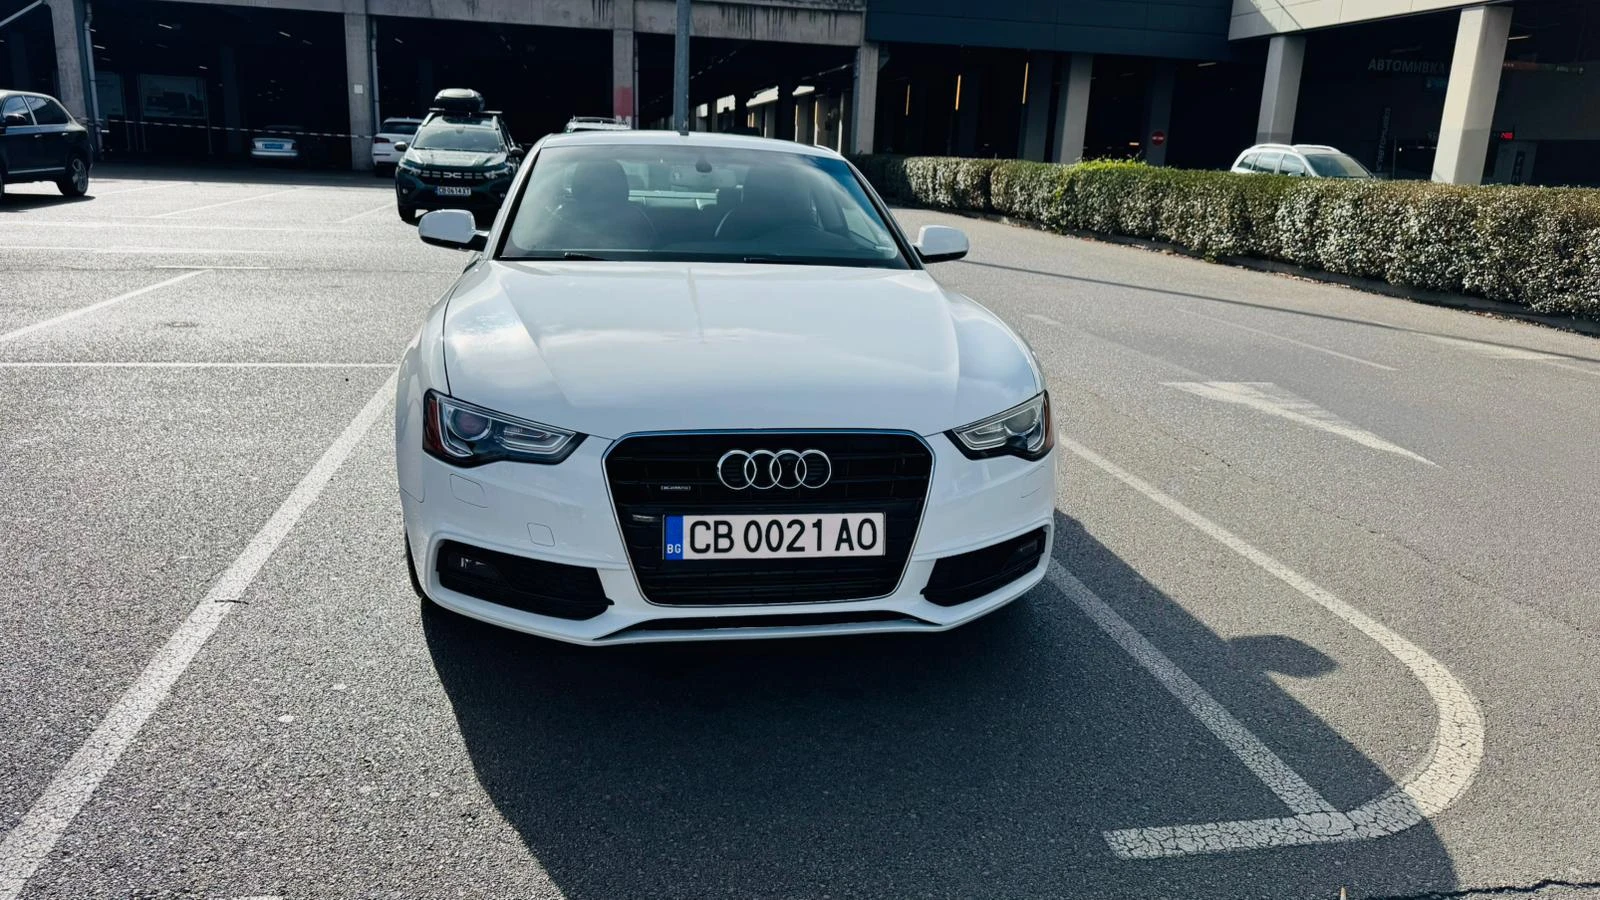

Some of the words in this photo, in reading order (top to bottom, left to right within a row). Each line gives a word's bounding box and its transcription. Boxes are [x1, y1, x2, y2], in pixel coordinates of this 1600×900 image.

[1367, 57, 1446, 74] АВТОМИВКА
[689, 520, 735, 554] CB
[743, 518, 823, 552] 0021
[834, 517, 878, 551] AO
[666, 543, 682, 554] BG
